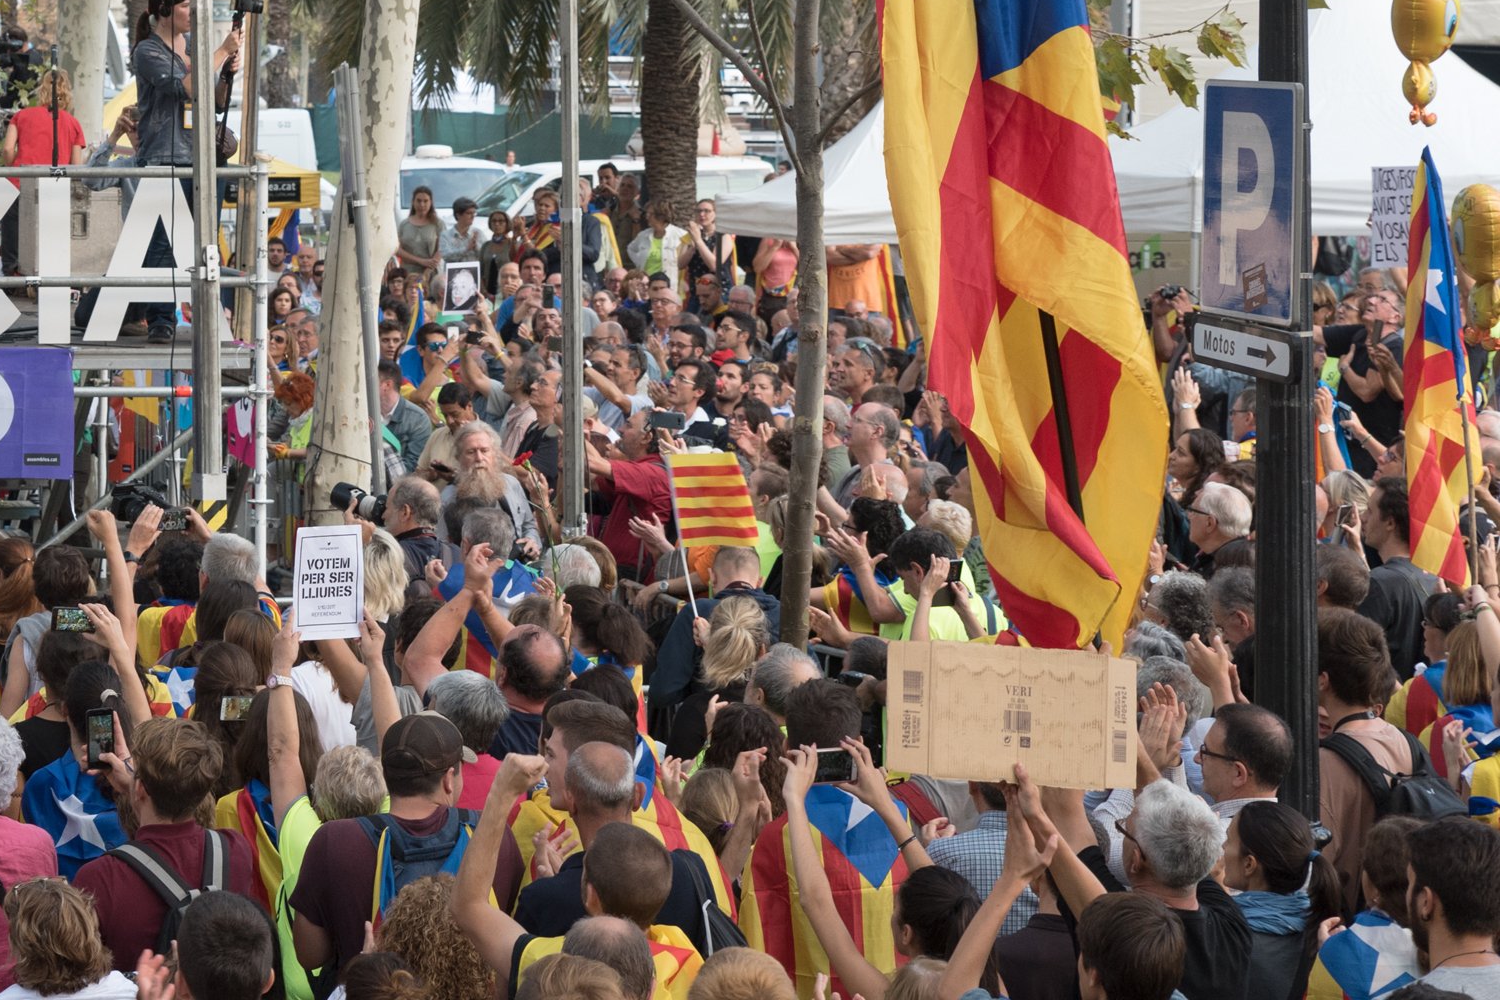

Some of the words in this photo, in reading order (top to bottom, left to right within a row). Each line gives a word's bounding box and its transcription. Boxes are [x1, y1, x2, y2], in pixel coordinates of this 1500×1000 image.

[1219, 111, 1275, 286] P
[1375, 242, 1399, 263] ELS
[1203, 330, 1236, 356] Motos
[306, 557, 351, 571] VOTEM
[301, 572, 326, 585] PER
[329, 571, 354, 584] SER
[301, 585, 353, 600] LLIURES
[1005, 684, 1032, 697] VERI
